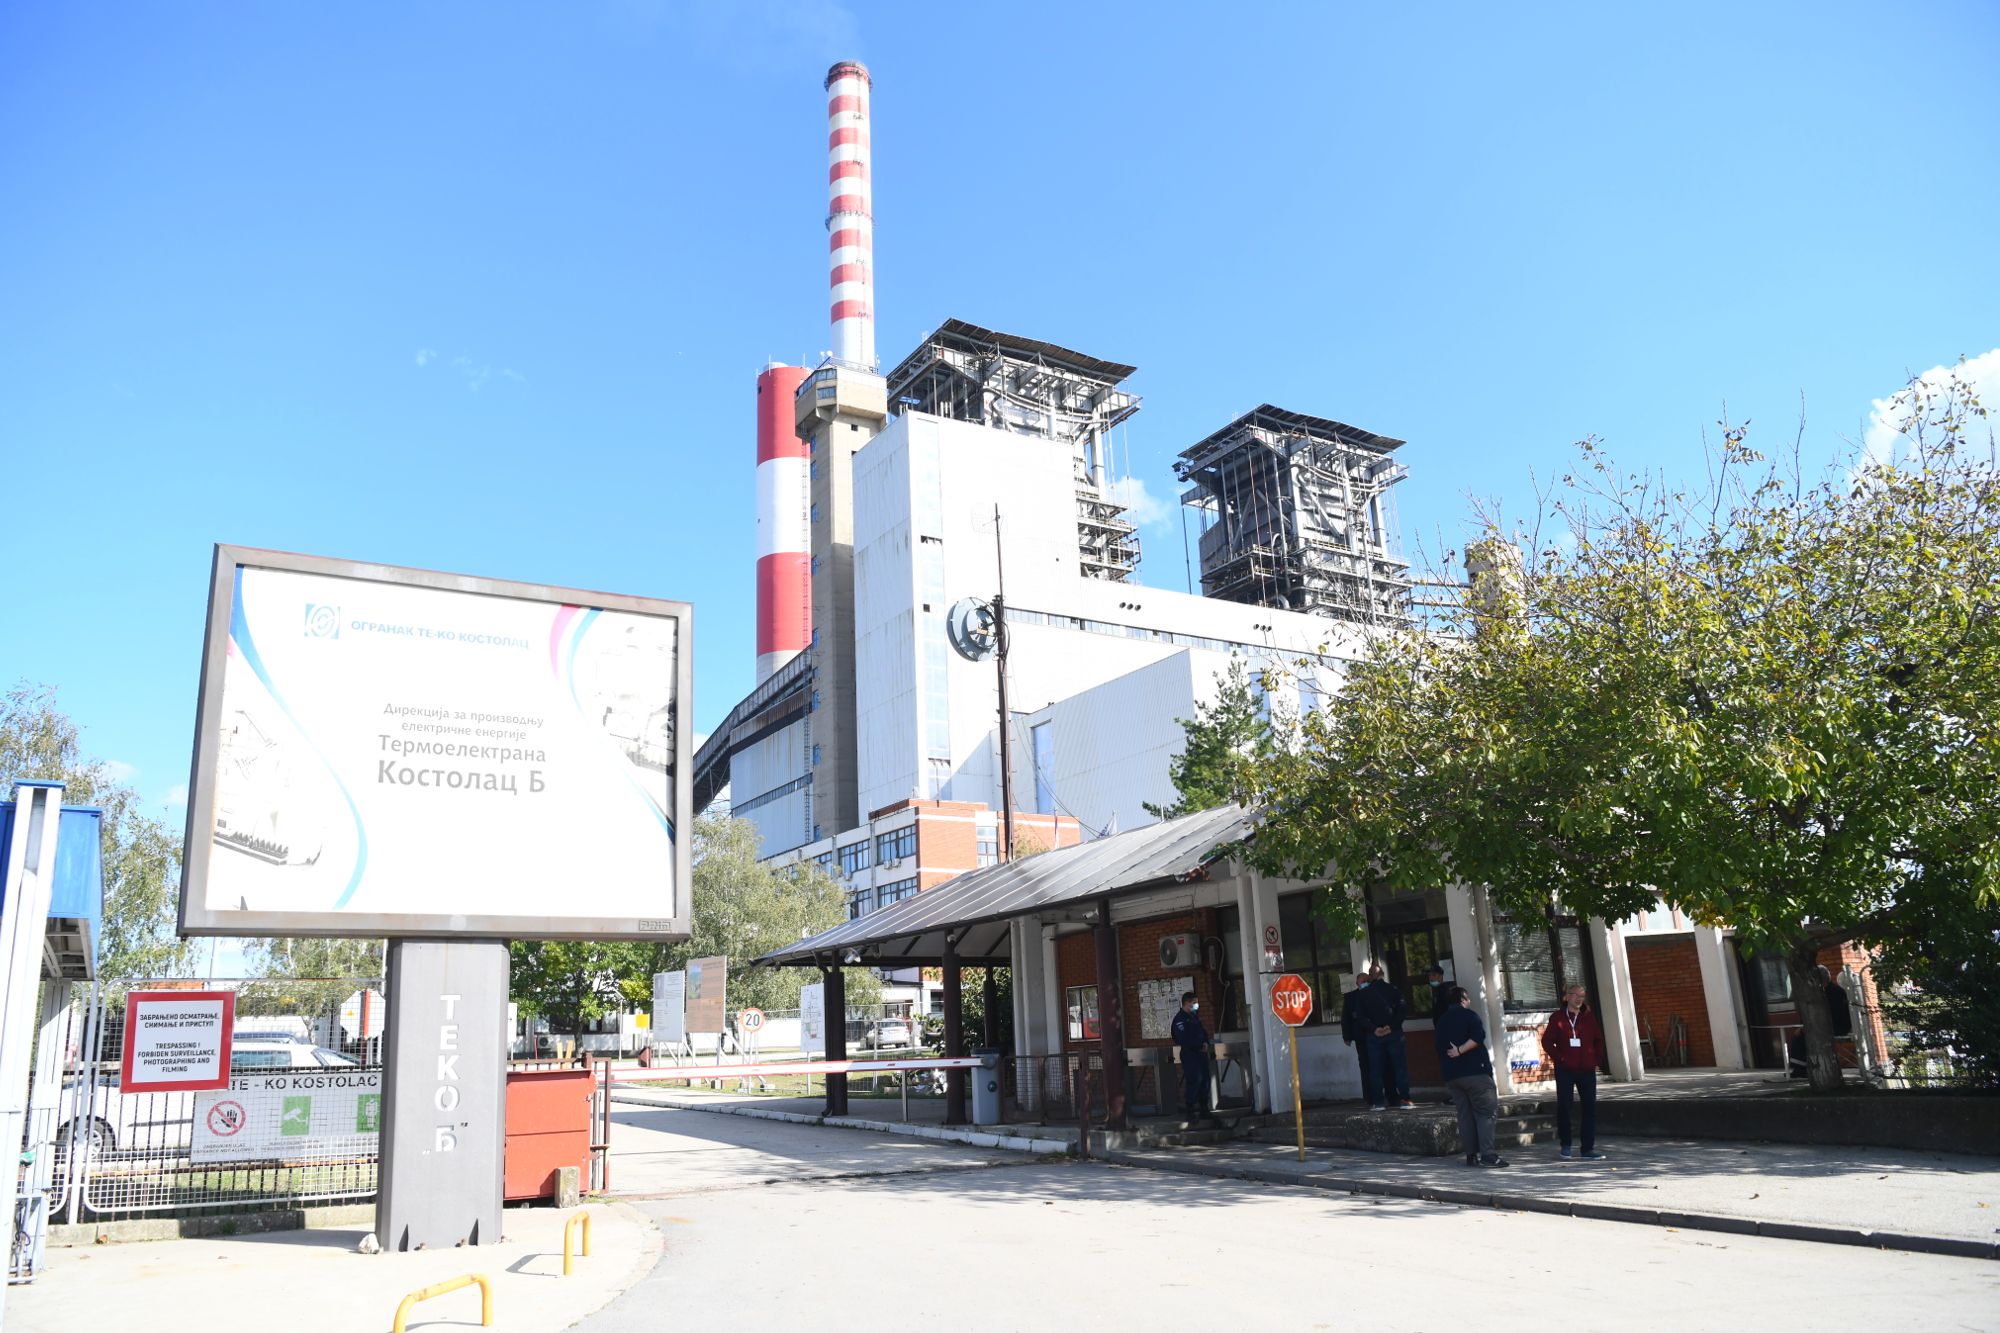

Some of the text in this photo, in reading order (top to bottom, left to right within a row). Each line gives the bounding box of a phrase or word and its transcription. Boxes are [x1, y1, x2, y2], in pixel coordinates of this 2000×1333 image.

[351, 620, 529, 650] ОГРАНАК ТЕ-КО КОСТОЛАЦ
[384, 703, 544, 728] Дирекција за производњу
[401, 722, 527, 741] електричне енергије
[378, 734, 546, 764] Термоелектрана
[378, 760, 546, 796] Костолац Б
[1276, 991, 1307, 1009] STOP
[745, 1013, 760, 1027] 20
[264, 1078, 287, 1090] KO
[293, 1075, 378, 1089] KOSTOLAC
